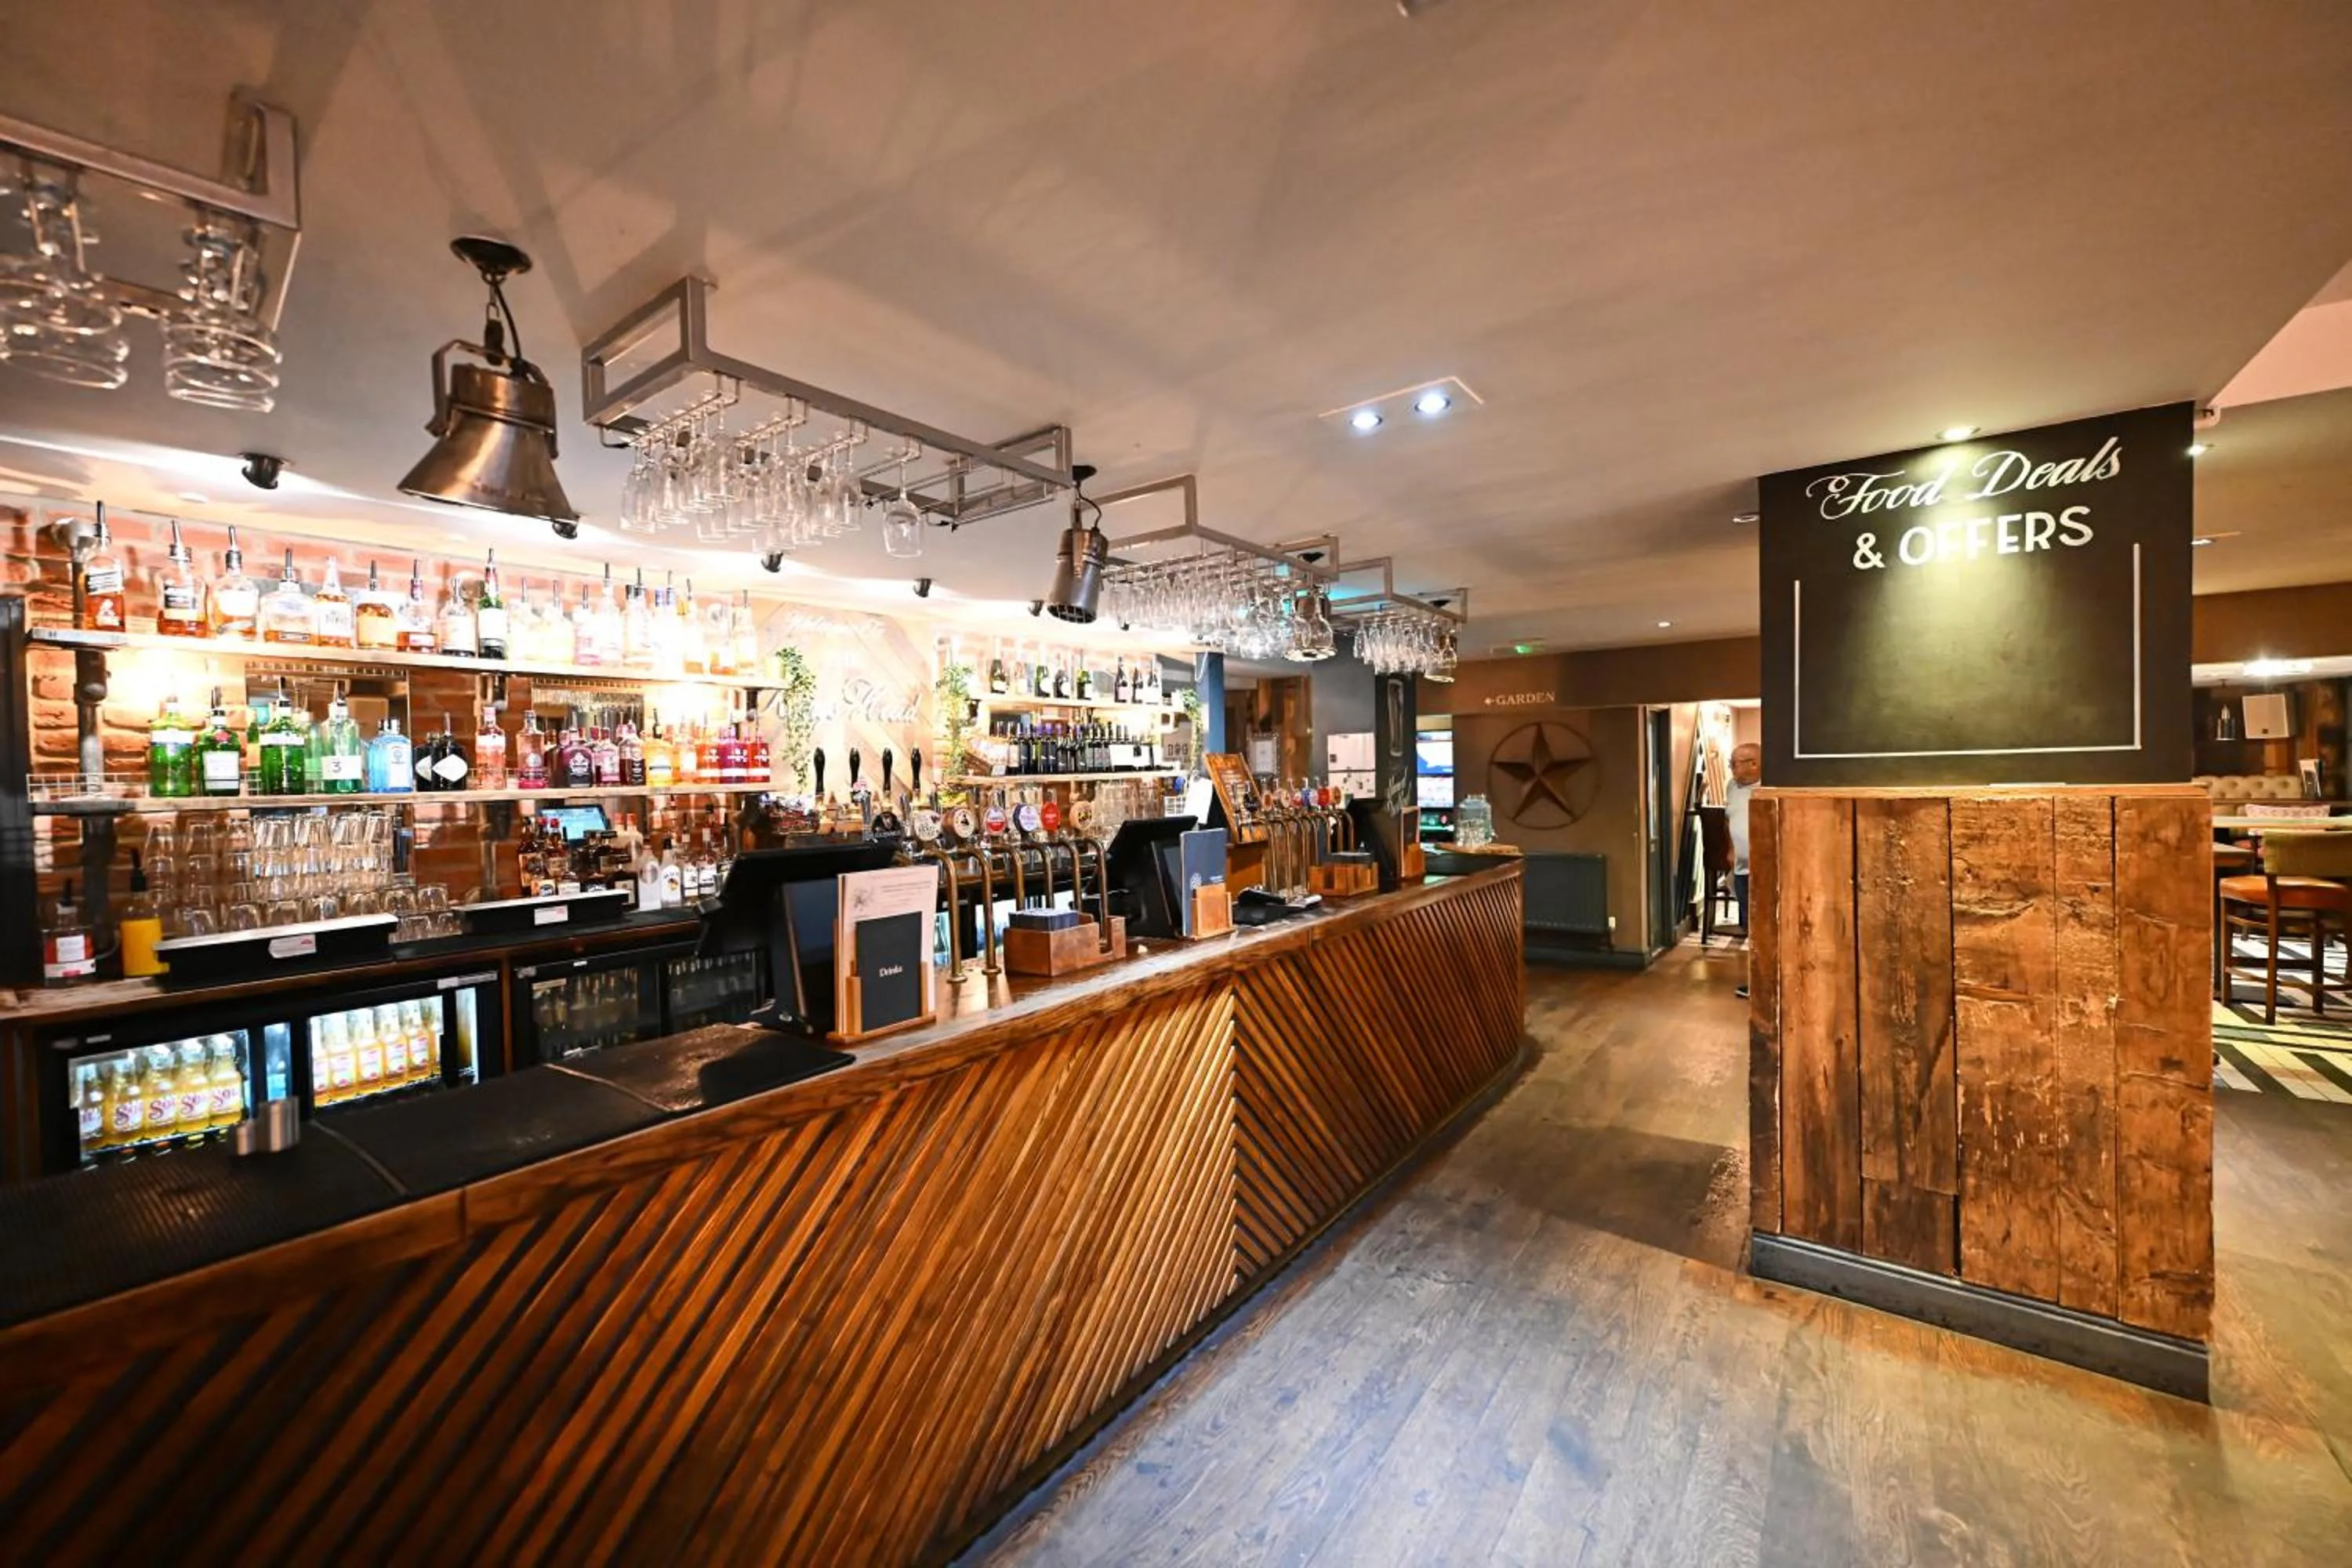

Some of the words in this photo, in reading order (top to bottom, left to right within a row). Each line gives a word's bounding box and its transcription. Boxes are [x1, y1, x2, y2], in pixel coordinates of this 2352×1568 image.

[1806, 458, 1957, 520] Food
[1965, 437, 2122, 501] Deals
[1853, 532, 1886, 569] &
[1899, 506, 2094, 565] OFFERS
[1497, 691, 1555, 706] GARDEN
[879, 965, 903, 978] Drinks
